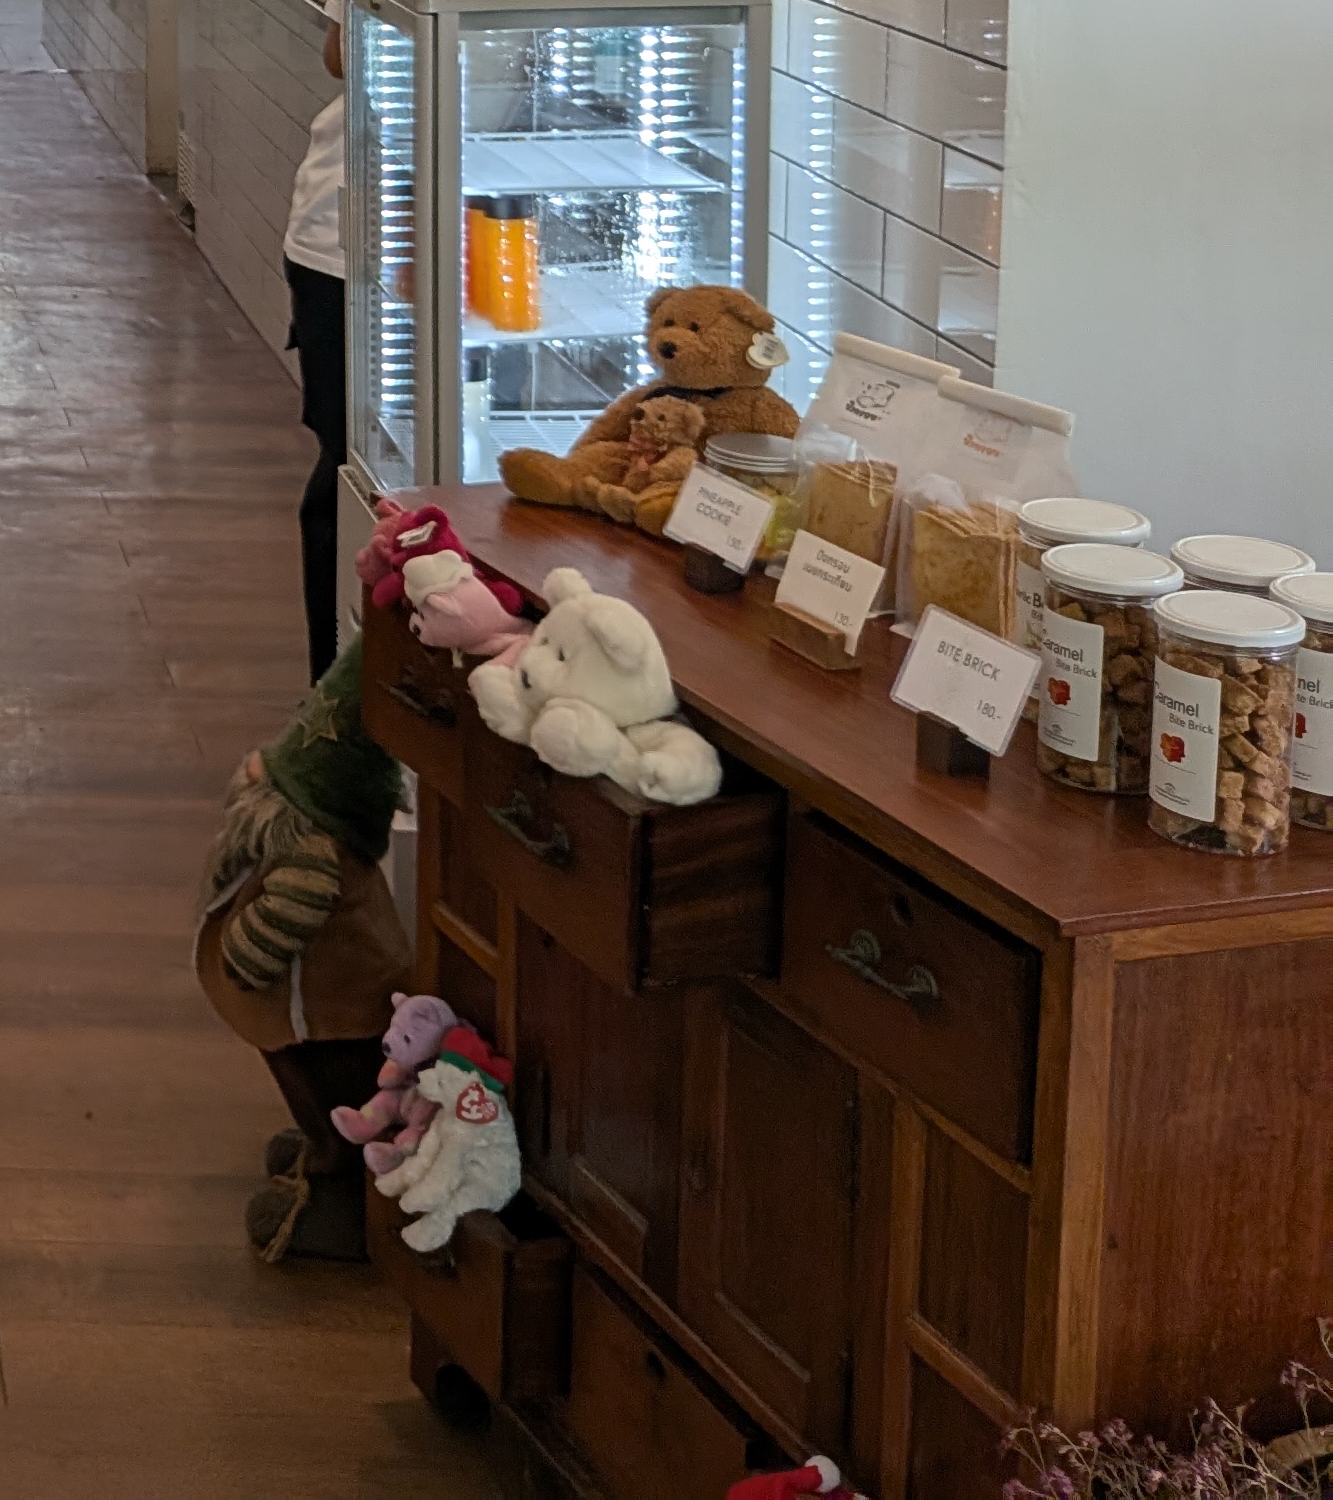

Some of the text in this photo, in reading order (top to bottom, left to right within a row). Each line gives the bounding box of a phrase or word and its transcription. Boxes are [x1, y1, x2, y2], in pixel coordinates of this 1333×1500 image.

[696, 502, 732, 527] COOKIE
[937, 640, 1001, 682] BITE BRICK
[1072, 664, 1097, 679] Brick
[977, 699, 1002, 720] 180.-
[1169, 712, 1215, 735] Bite Brick
